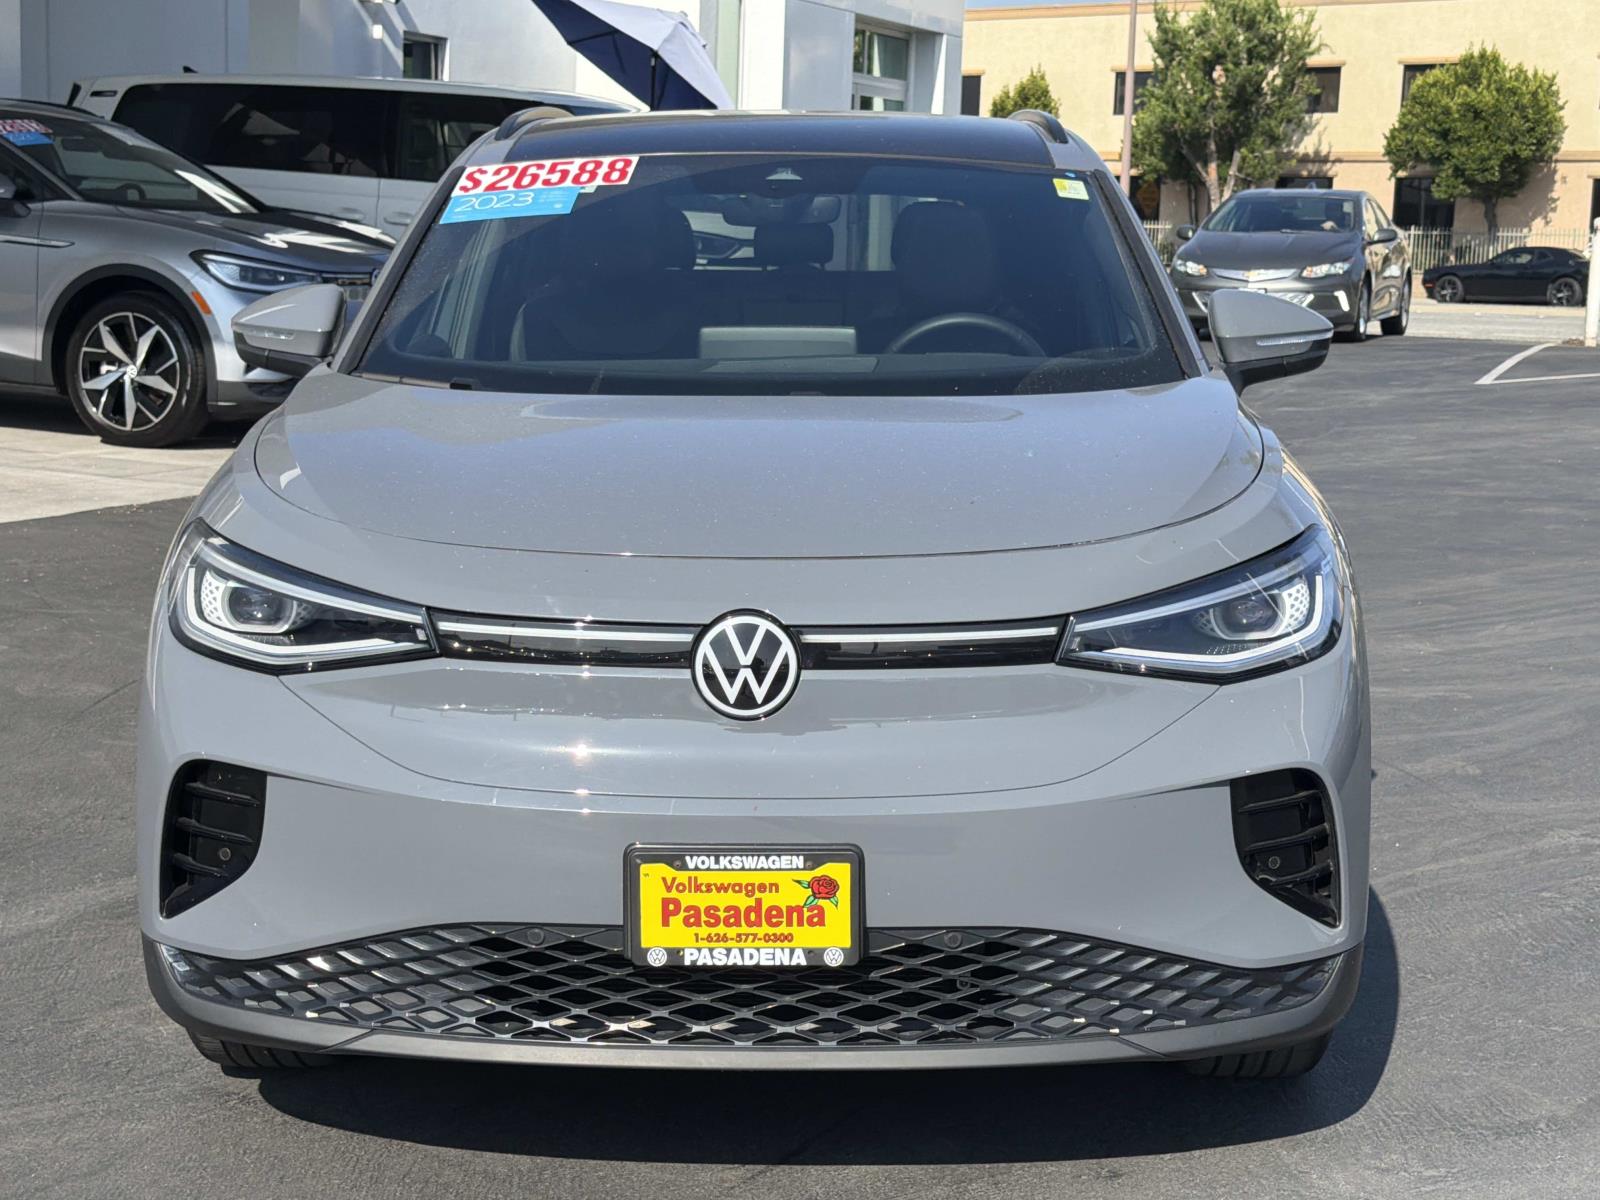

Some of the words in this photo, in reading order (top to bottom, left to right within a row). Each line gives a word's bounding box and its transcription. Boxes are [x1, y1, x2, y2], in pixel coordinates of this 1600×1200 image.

[459, 158, 633, 192] $26588
[454, 192, 534, 212] 2023
[685, 855, 804, 869] VOLKSWAGEN
[661, 876, 780, 898] Volkswagen
[661, 897, 826, 928] Pasadena
[693, 932, 794, 944] 1-626-577-0300
[683, 947, 807, 966] PASADENA
